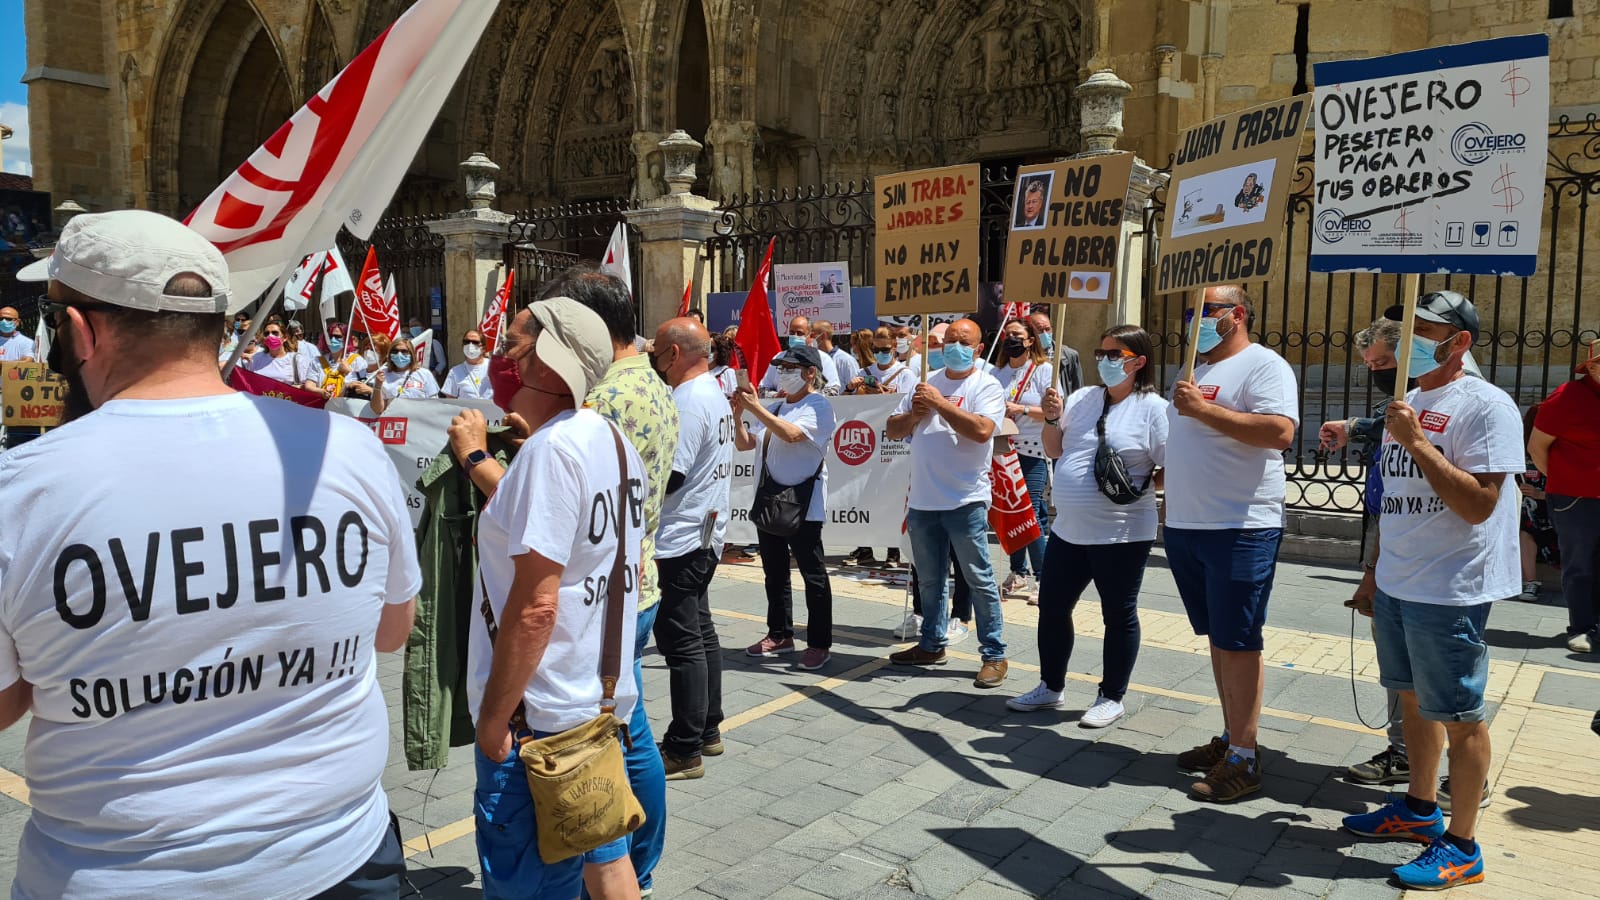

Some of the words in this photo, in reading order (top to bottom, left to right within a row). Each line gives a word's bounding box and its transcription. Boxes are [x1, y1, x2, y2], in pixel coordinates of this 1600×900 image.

[1320, 79, 1482, 131] OVEJERO
[1176, 119, 1226, 166] JUAN
[1232, 100, 1304, 150] PABLO
[1324, 124, 1434, 160] PESETERO
[1464, 133, 1526, 151] OVEJERO
[1339, 151, 1398, 174] PAGA
[1407, 148, 1426, 168] A
[883, 182, 907, 209] SIN
[911, 174, 975, 204] TRABA-
[1064, 164, 1102, 198] NO
[1316, 178, 1354, 204] TUS
[1362, 170, 1473, 199] OBREROS
[887, 201, 964, 231] JADORES
[1049, 198, 1123, 227] TIENES
[1325, 218, 1372, 232] OVEJERO
[885, 244, 907, 266] NO
[920, 239, 960, 266] HAY
[1019, 235, 1117, 267] PALABRA
[884, 268, 971, 302] EMPRESA
[1041, 272, 1067, 298] NI
[784, 306, 820, 318] AHORA
[8, 366, 64, 383] OVEJE
[21, 385, 34, 402] O
[5, 405, 15, 418] O
[20, 404, 65, 419] NOSOT
[840, 427, 871, 447] UGT
[832, 507, 870, 524] LEÓN
[1406, 496, 1423, 514] YA
[53, 510, 369, 629] OVEJERO
[69, 647, 264, 719] SOLUCIÓN
[277, 647, 315, 687] YA
[325, 635, 360, 680] !!!
